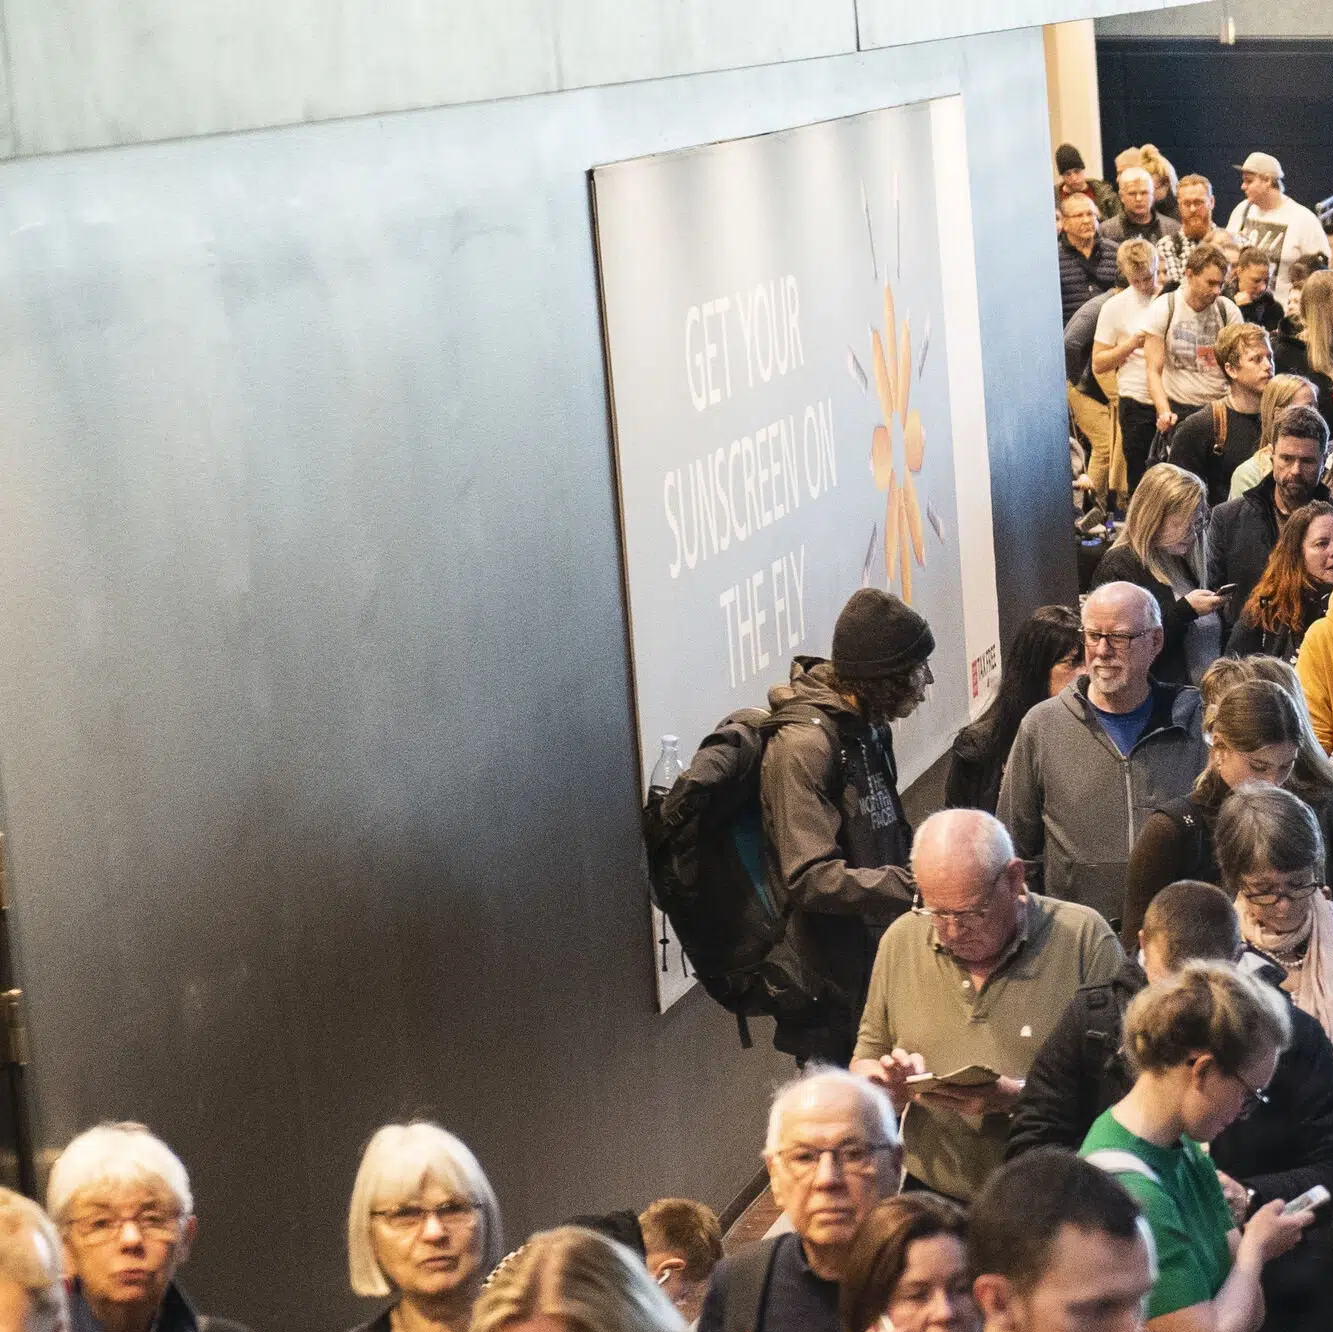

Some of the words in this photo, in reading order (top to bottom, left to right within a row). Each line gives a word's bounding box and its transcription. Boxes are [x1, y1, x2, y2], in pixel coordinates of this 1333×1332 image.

[685, 297, 732, 411] GET
[735, 274, 804, 388] YOUR
[664, 414, 800, 578] SUNSCREEN
[803, 397, 838, 500] ON
[719, 568, 771, 689] THE
[771, 544, 806, 656] FLY
